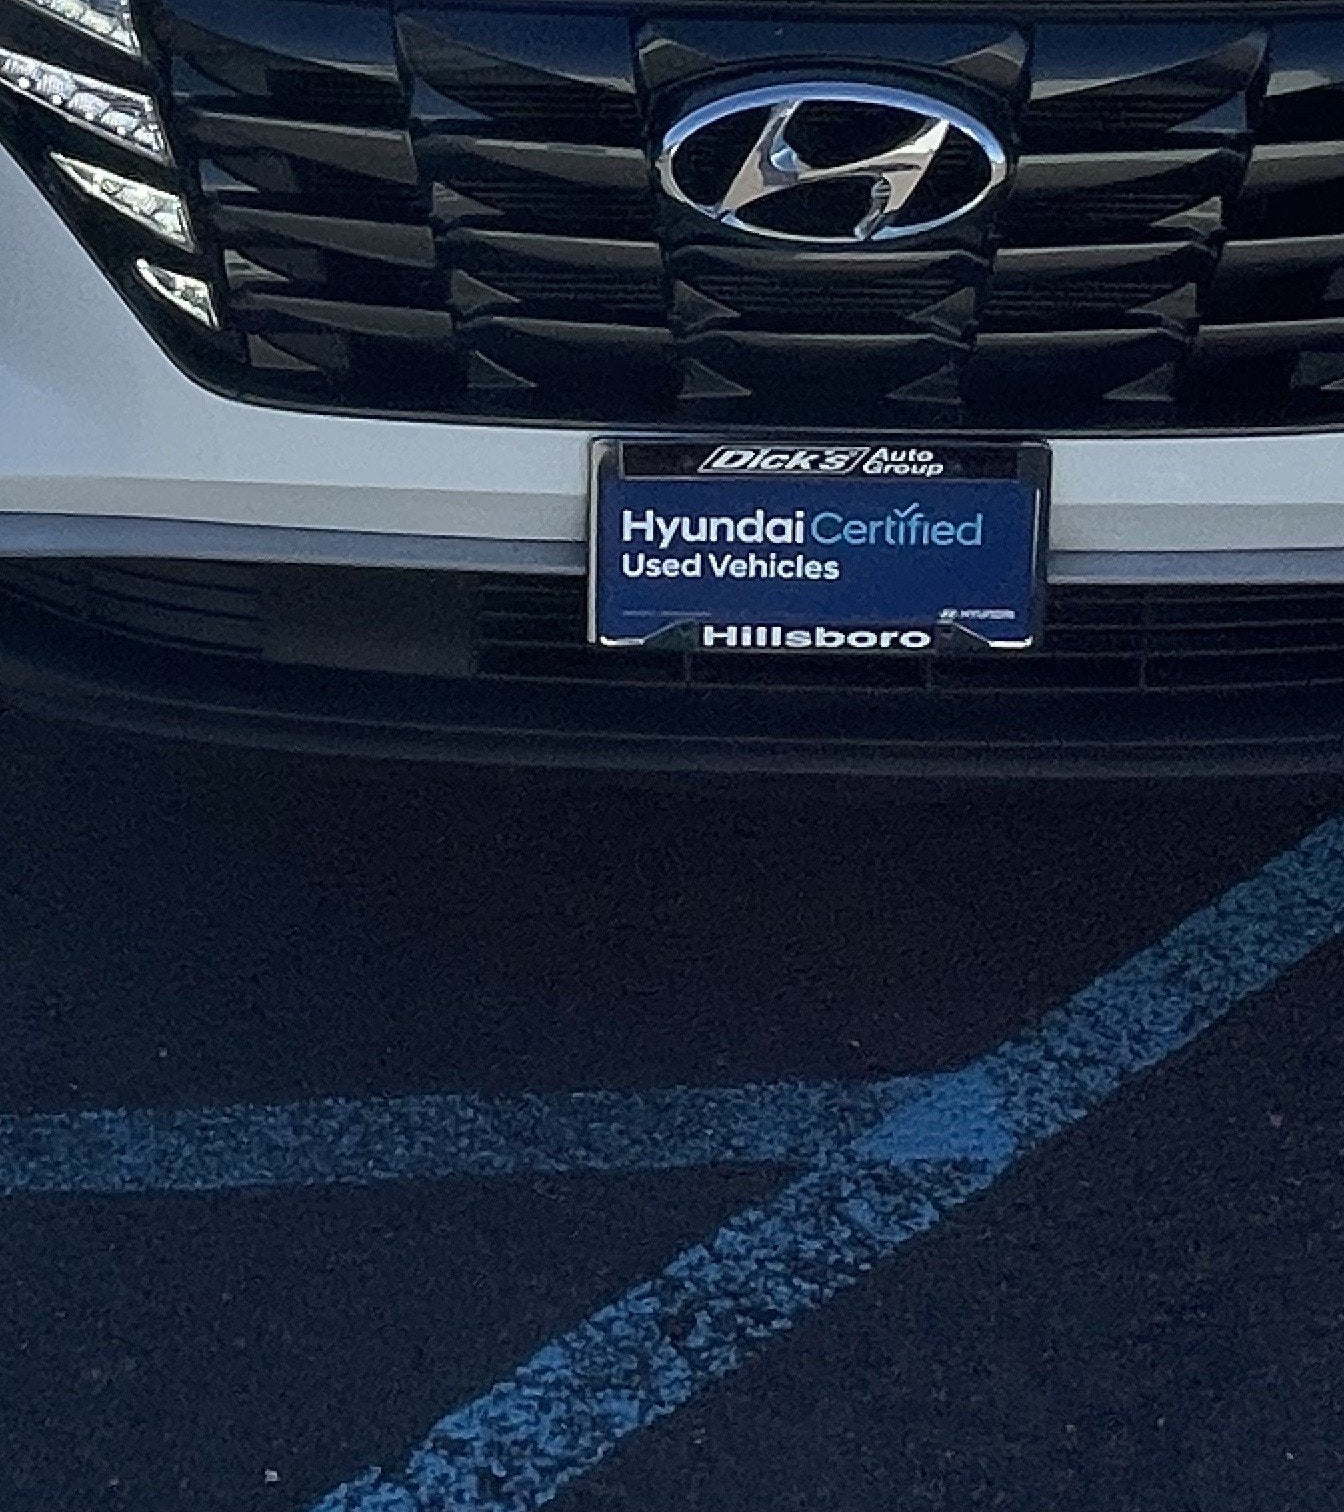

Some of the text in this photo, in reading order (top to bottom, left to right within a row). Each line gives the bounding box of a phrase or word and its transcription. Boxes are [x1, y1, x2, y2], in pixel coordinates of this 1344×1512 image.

[870, 446, 934, 463] Auto
[862, 462, 945, 478] Group
[622, 505, 984, 549] Hyundai Certified
[622, 553, 840, 580] Used Vehicles
[702, 625, 931, 648] Hillsboro
